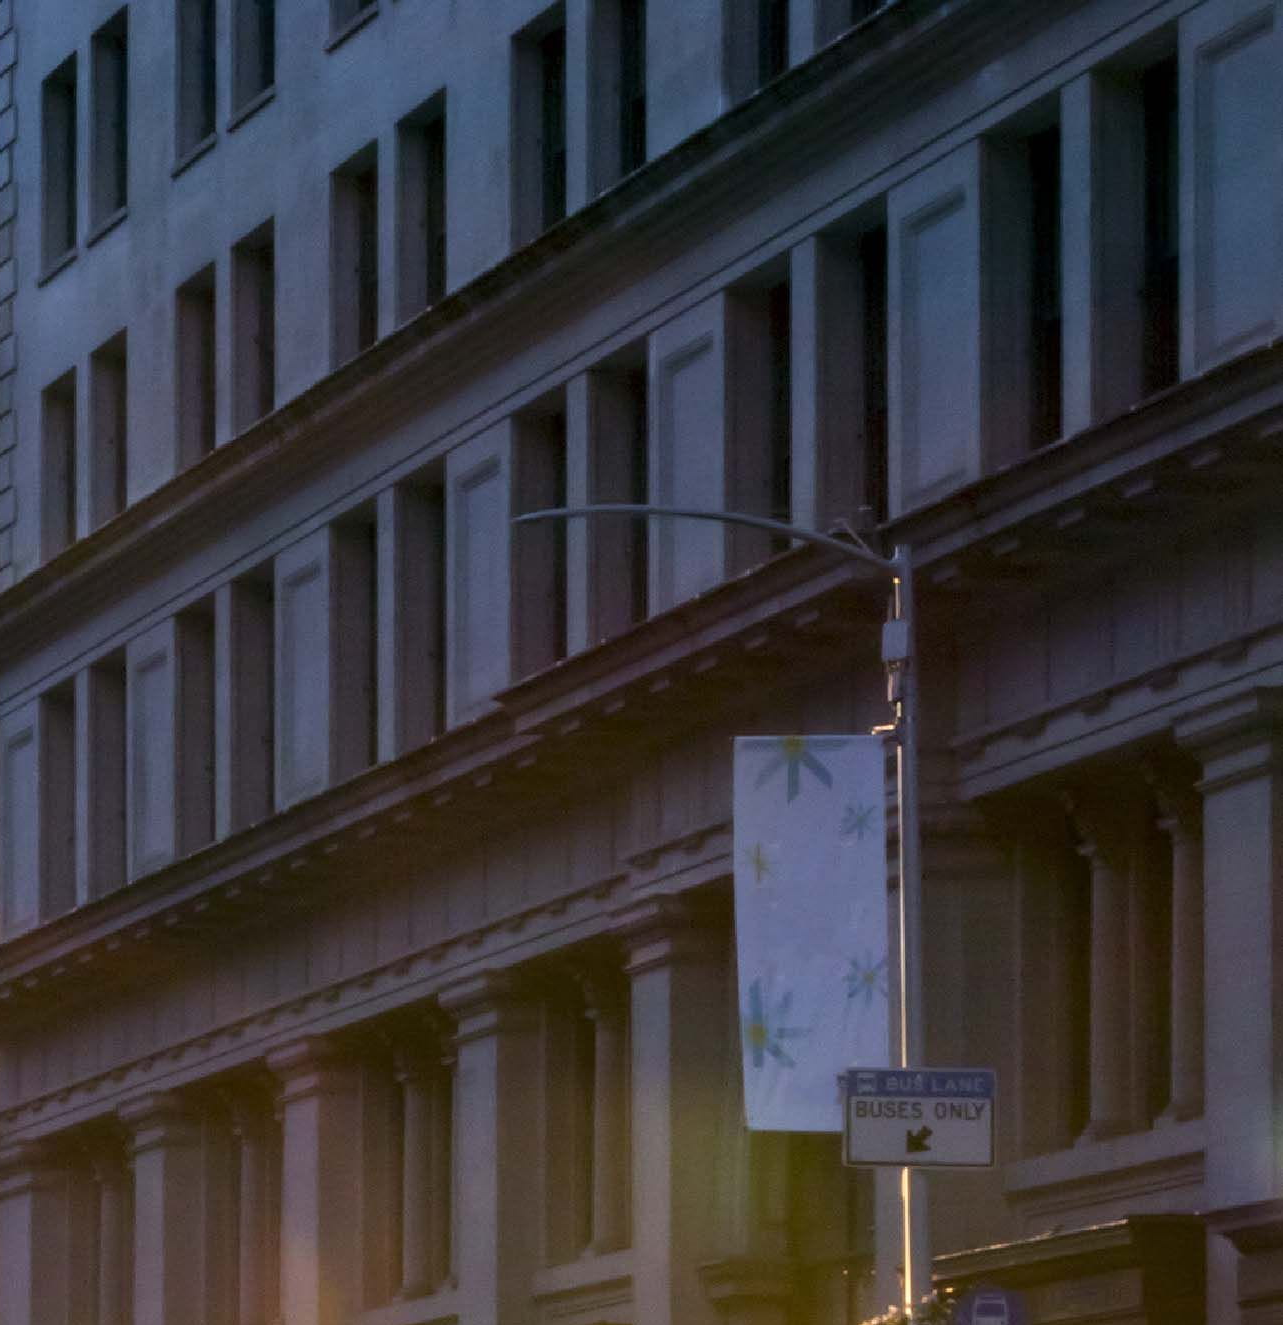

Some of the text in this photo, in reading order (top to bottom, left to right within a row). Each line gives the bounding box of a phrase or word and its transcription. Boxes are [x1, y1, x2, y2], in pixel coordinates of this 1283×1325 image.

[886, 1075, 985, 1092] BUS LANE
[855, 1101, 986, 1120] BUSES ONLY
